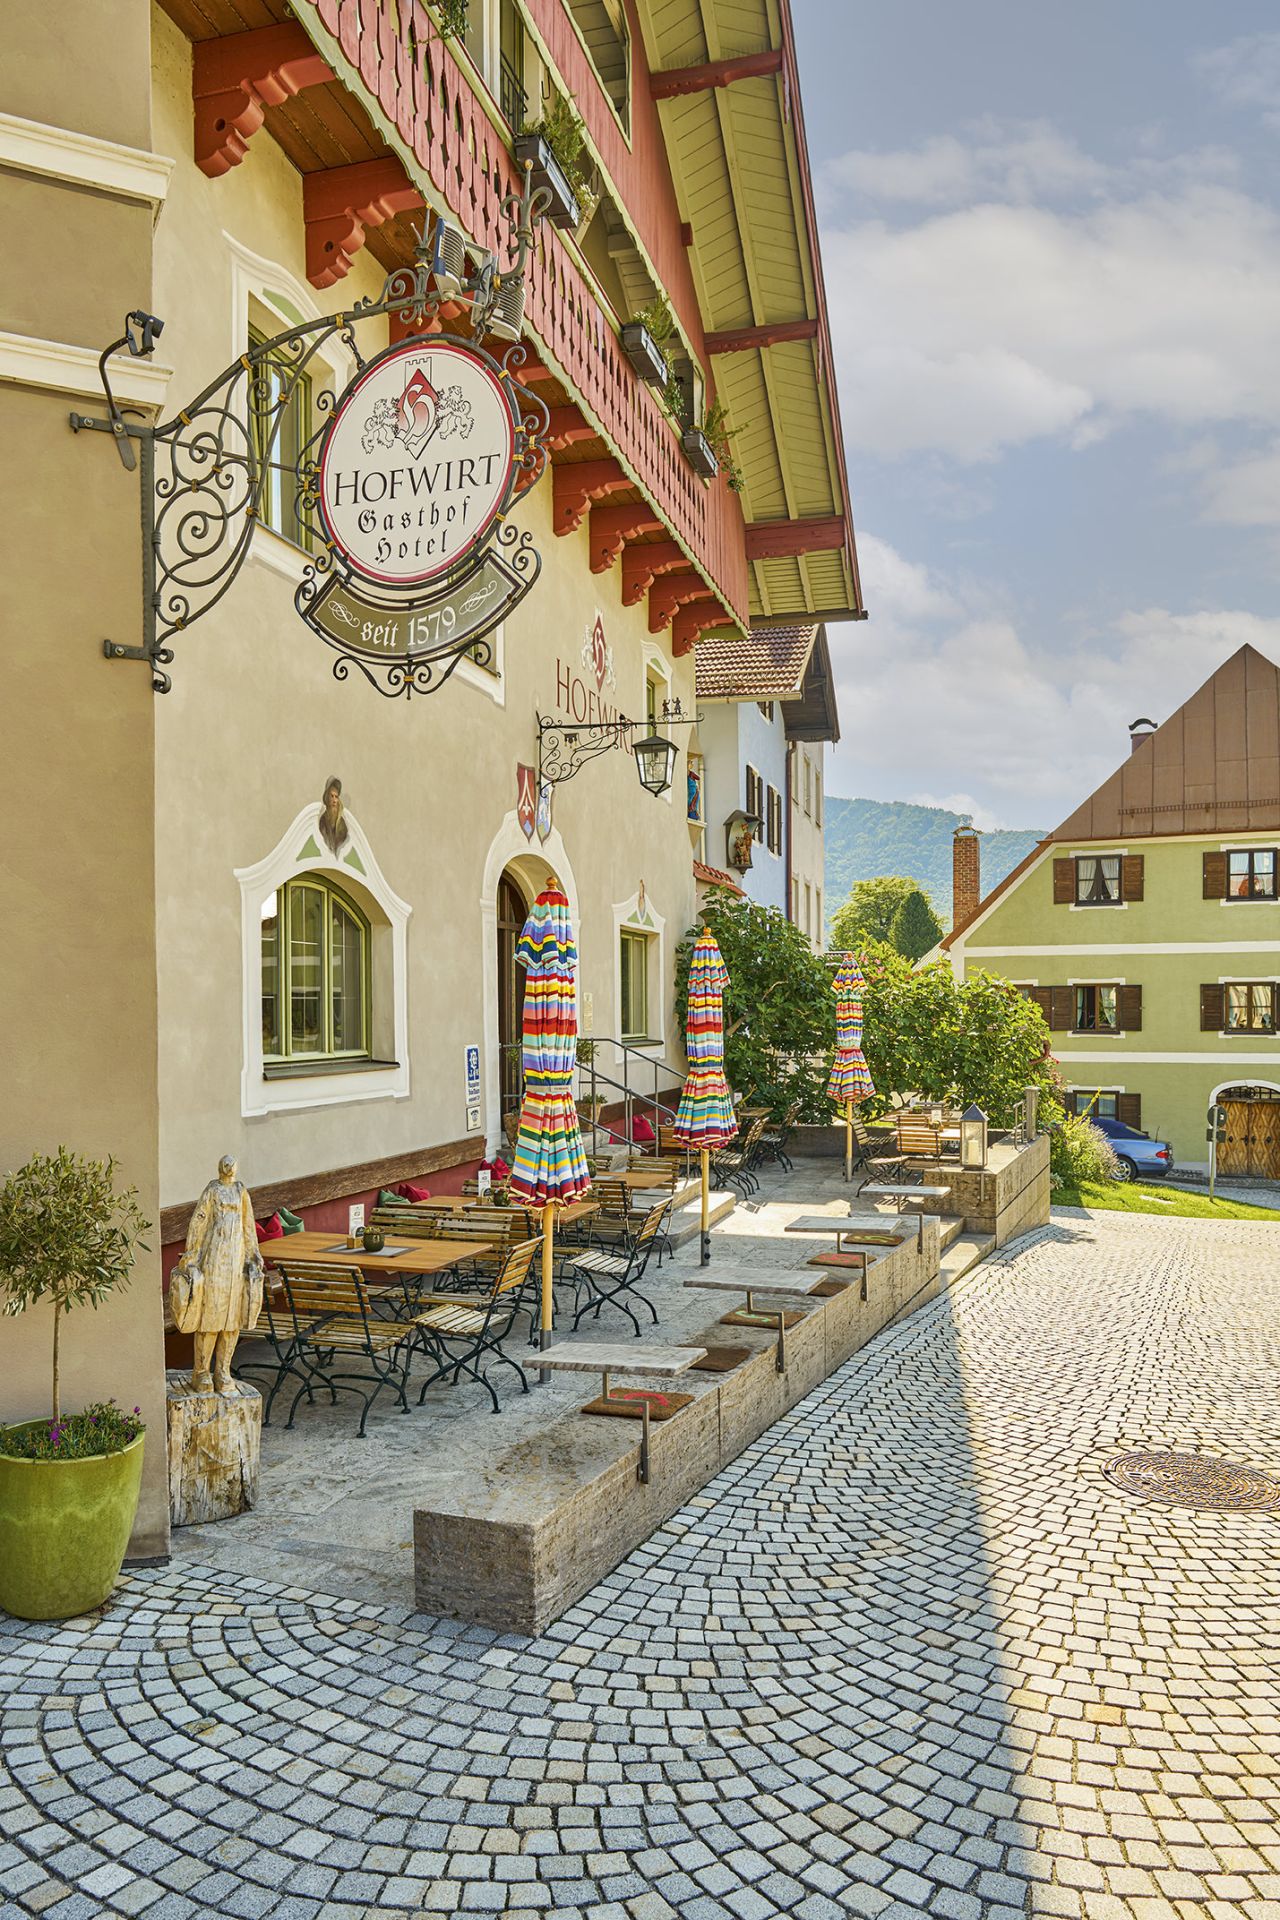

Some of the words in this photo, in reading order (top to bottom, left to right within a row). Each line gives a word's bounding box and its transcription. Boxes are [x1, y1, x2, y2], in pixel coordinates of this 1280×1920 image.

[333, 453, 501, 507] HOFWIRT
[358, 496, 471, 534] Gasthof
[374, 530, 448, 565] Hotel
[361, 622, 399, 648] seit
[407, 606, 458, 648] 1579
